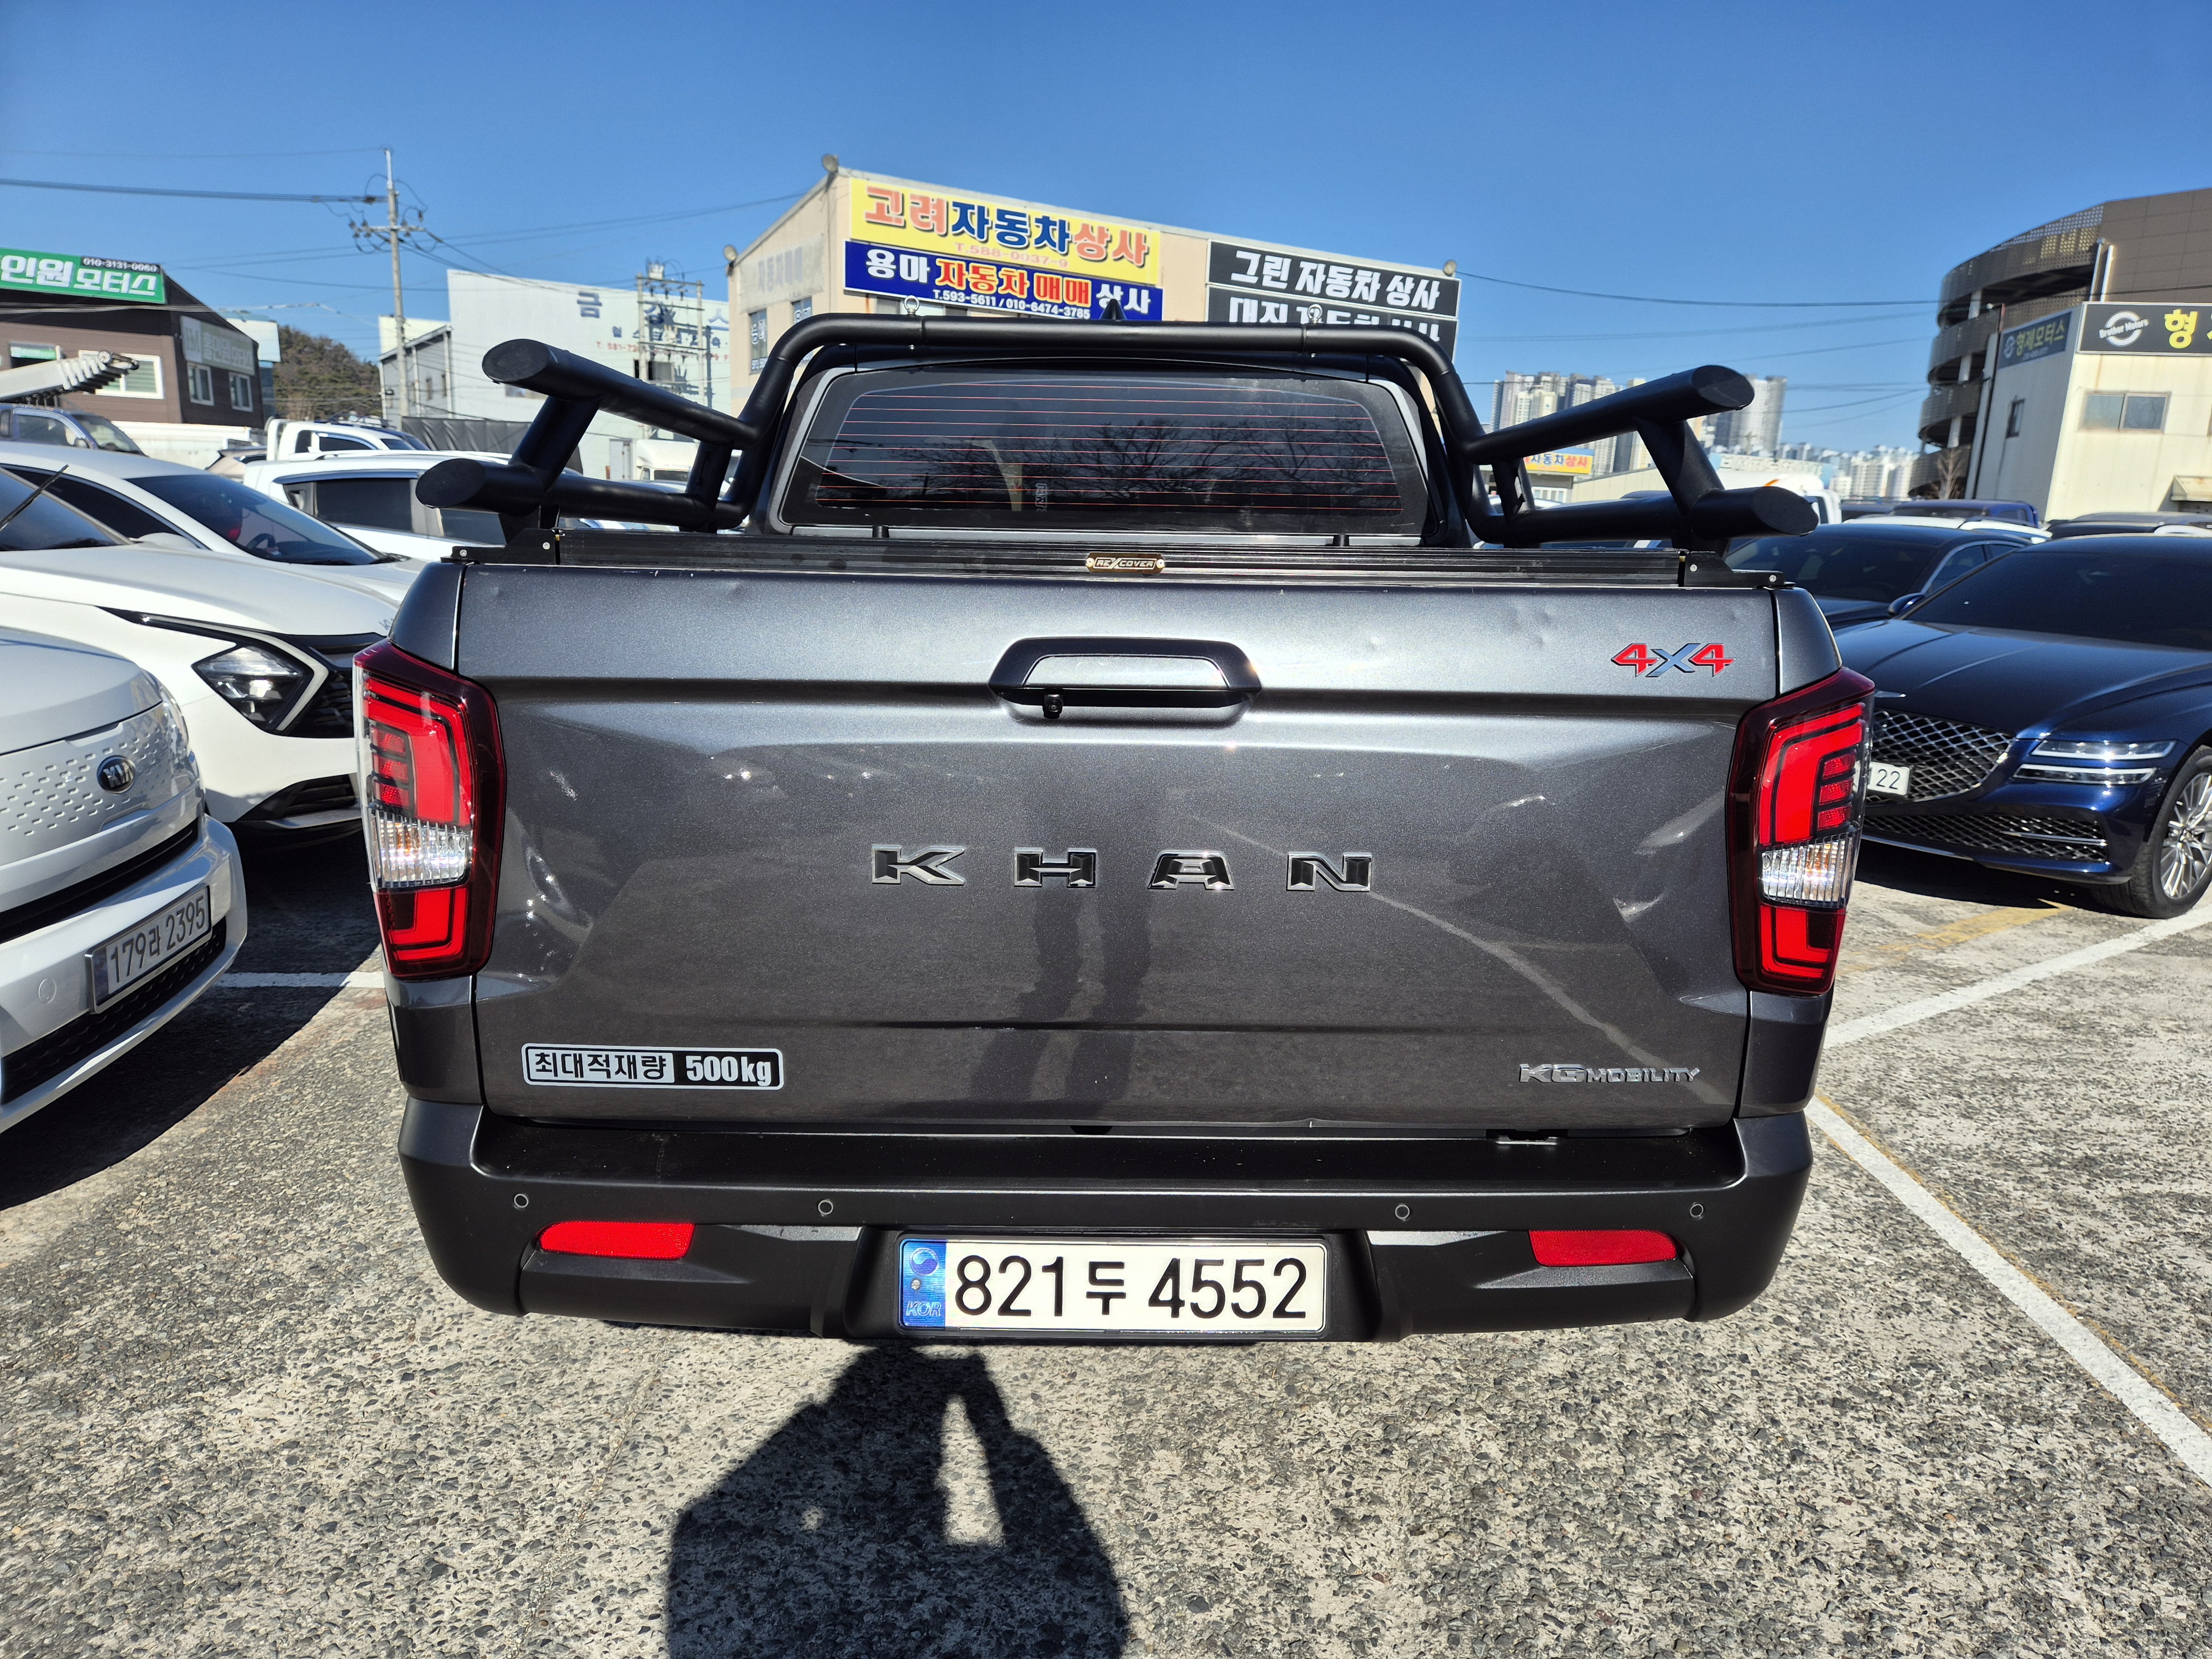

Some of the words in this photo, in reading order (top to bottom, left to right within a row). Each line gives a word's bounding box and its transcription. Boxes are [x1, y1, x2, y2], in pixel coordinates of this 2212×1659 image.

[865, 186, 1150, 268] 고려자동차상사
[0, 255, 74, 287] 인원
[73, 268, 157, 296] 모터스
[865, 248, 930, 284] 용마
[935, 258, 1030, 299] 자동차
[1034, 273, 1092, 308] 매매
[1096, 283, 1151, 315] 상사
[1230, 250, 1292, 289] 그린
[1295, 260, 1381, 302] 자동차
[1386, 274, 1441, 311] 상사
[932, 289, 997, 307] T.593-5611
[1006, 298, 1091, 320] 010-6474-3785
[2099, 325, 2125, 339] Brother
[2125, 319, 2149, 332] Motors
[2164, 309, 2212, 349] 형
[1525, 453, 1588, 468] 자동차상사
[871, 843, 1373, 892] KHAN
[111, 925, 161, 984] 179라
[166, 895, 205, 952] 2395
[534, 1052, 667, 1081] 최대적재량
[685, 1055, 773, 1087] 500kg
[1519, 1063, 1586, 1083] KG
[1586, 1067, 1701, 1083] MOBILITY
[955, 1255, 1126, 1317] 821두
[1147, 1258, 1307, 1319] 4552
[905, 1301, 942, 1316] KOR
